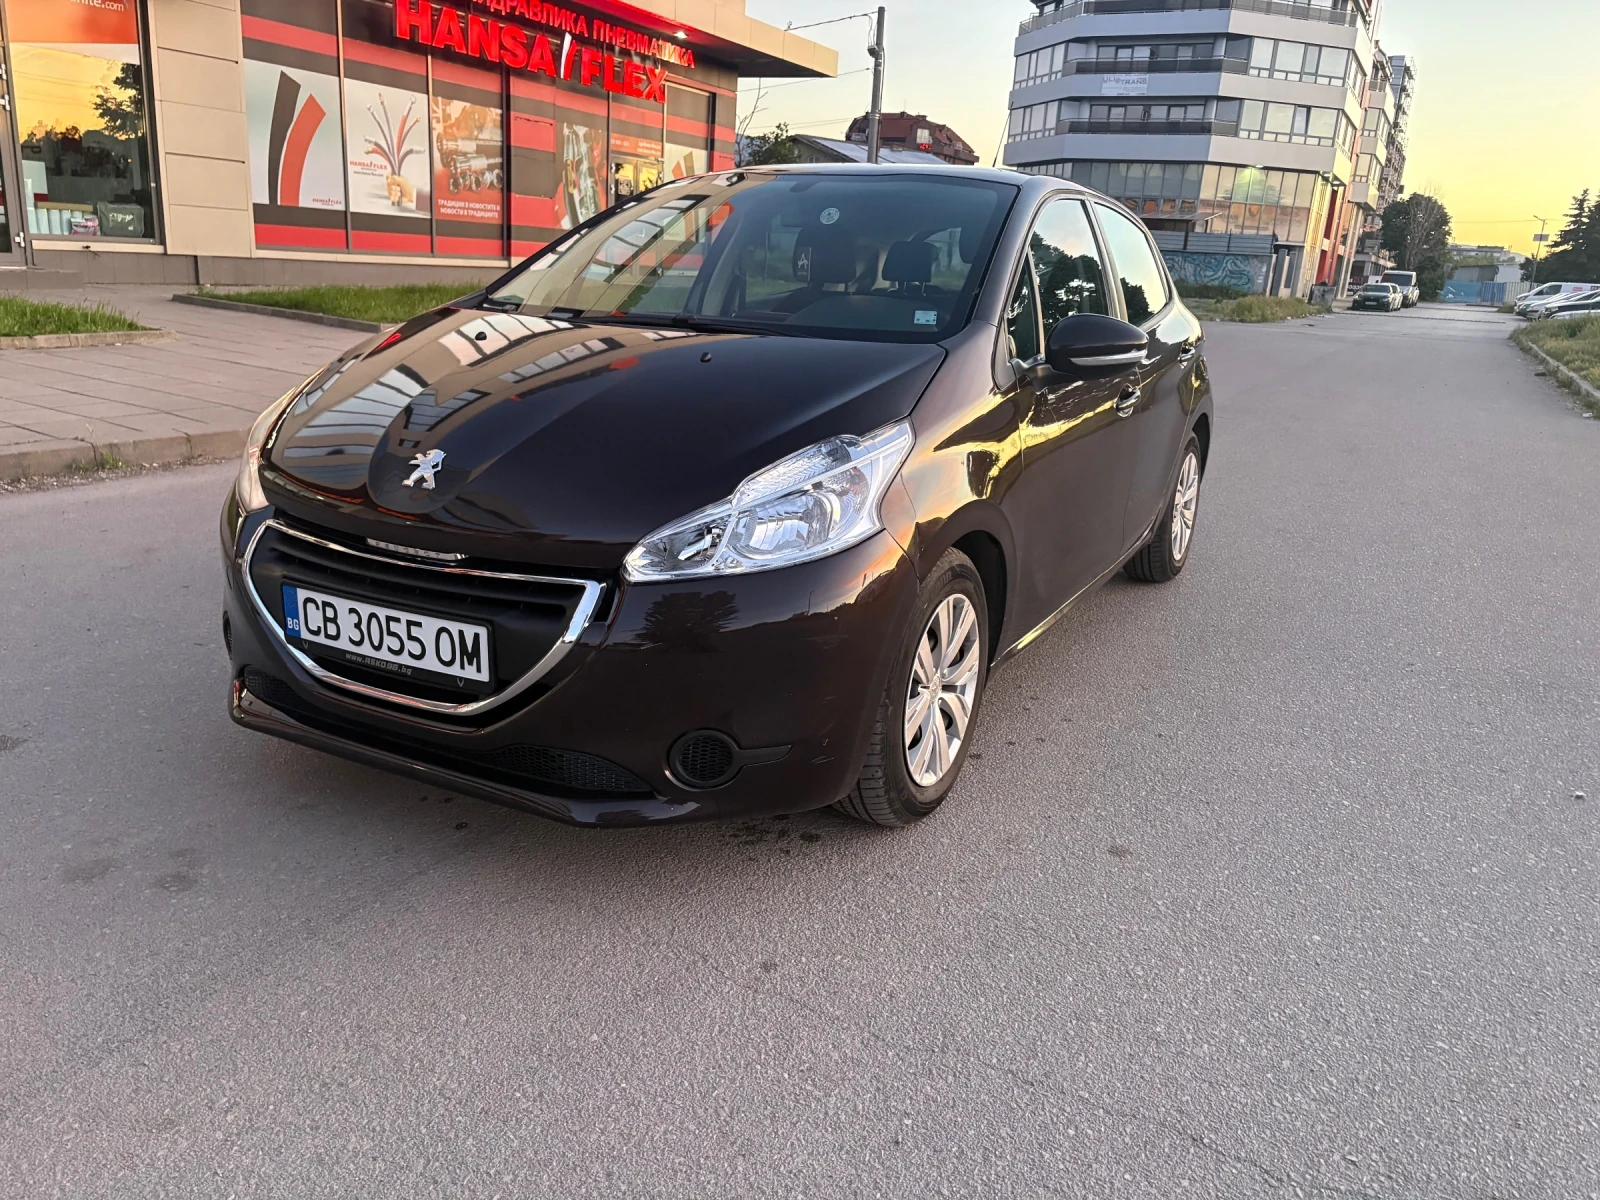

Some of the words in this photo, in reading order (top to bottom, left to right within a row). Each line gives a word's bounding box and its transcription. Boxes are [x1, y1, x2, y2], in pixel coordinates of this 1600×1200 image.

[394, 0, 556, 77] HANSA
[580, 47, 668, 104] FLEX
[592, 19, 695, 68] ПНЕВМАТИКА
[349, 160, 369, 168] HANSA
[287, 616, 300, 631] BG
[302, 596, 341, 641] CB
[348, 607, 427, 661] 3055
[434, 626, 482, 674] OM
